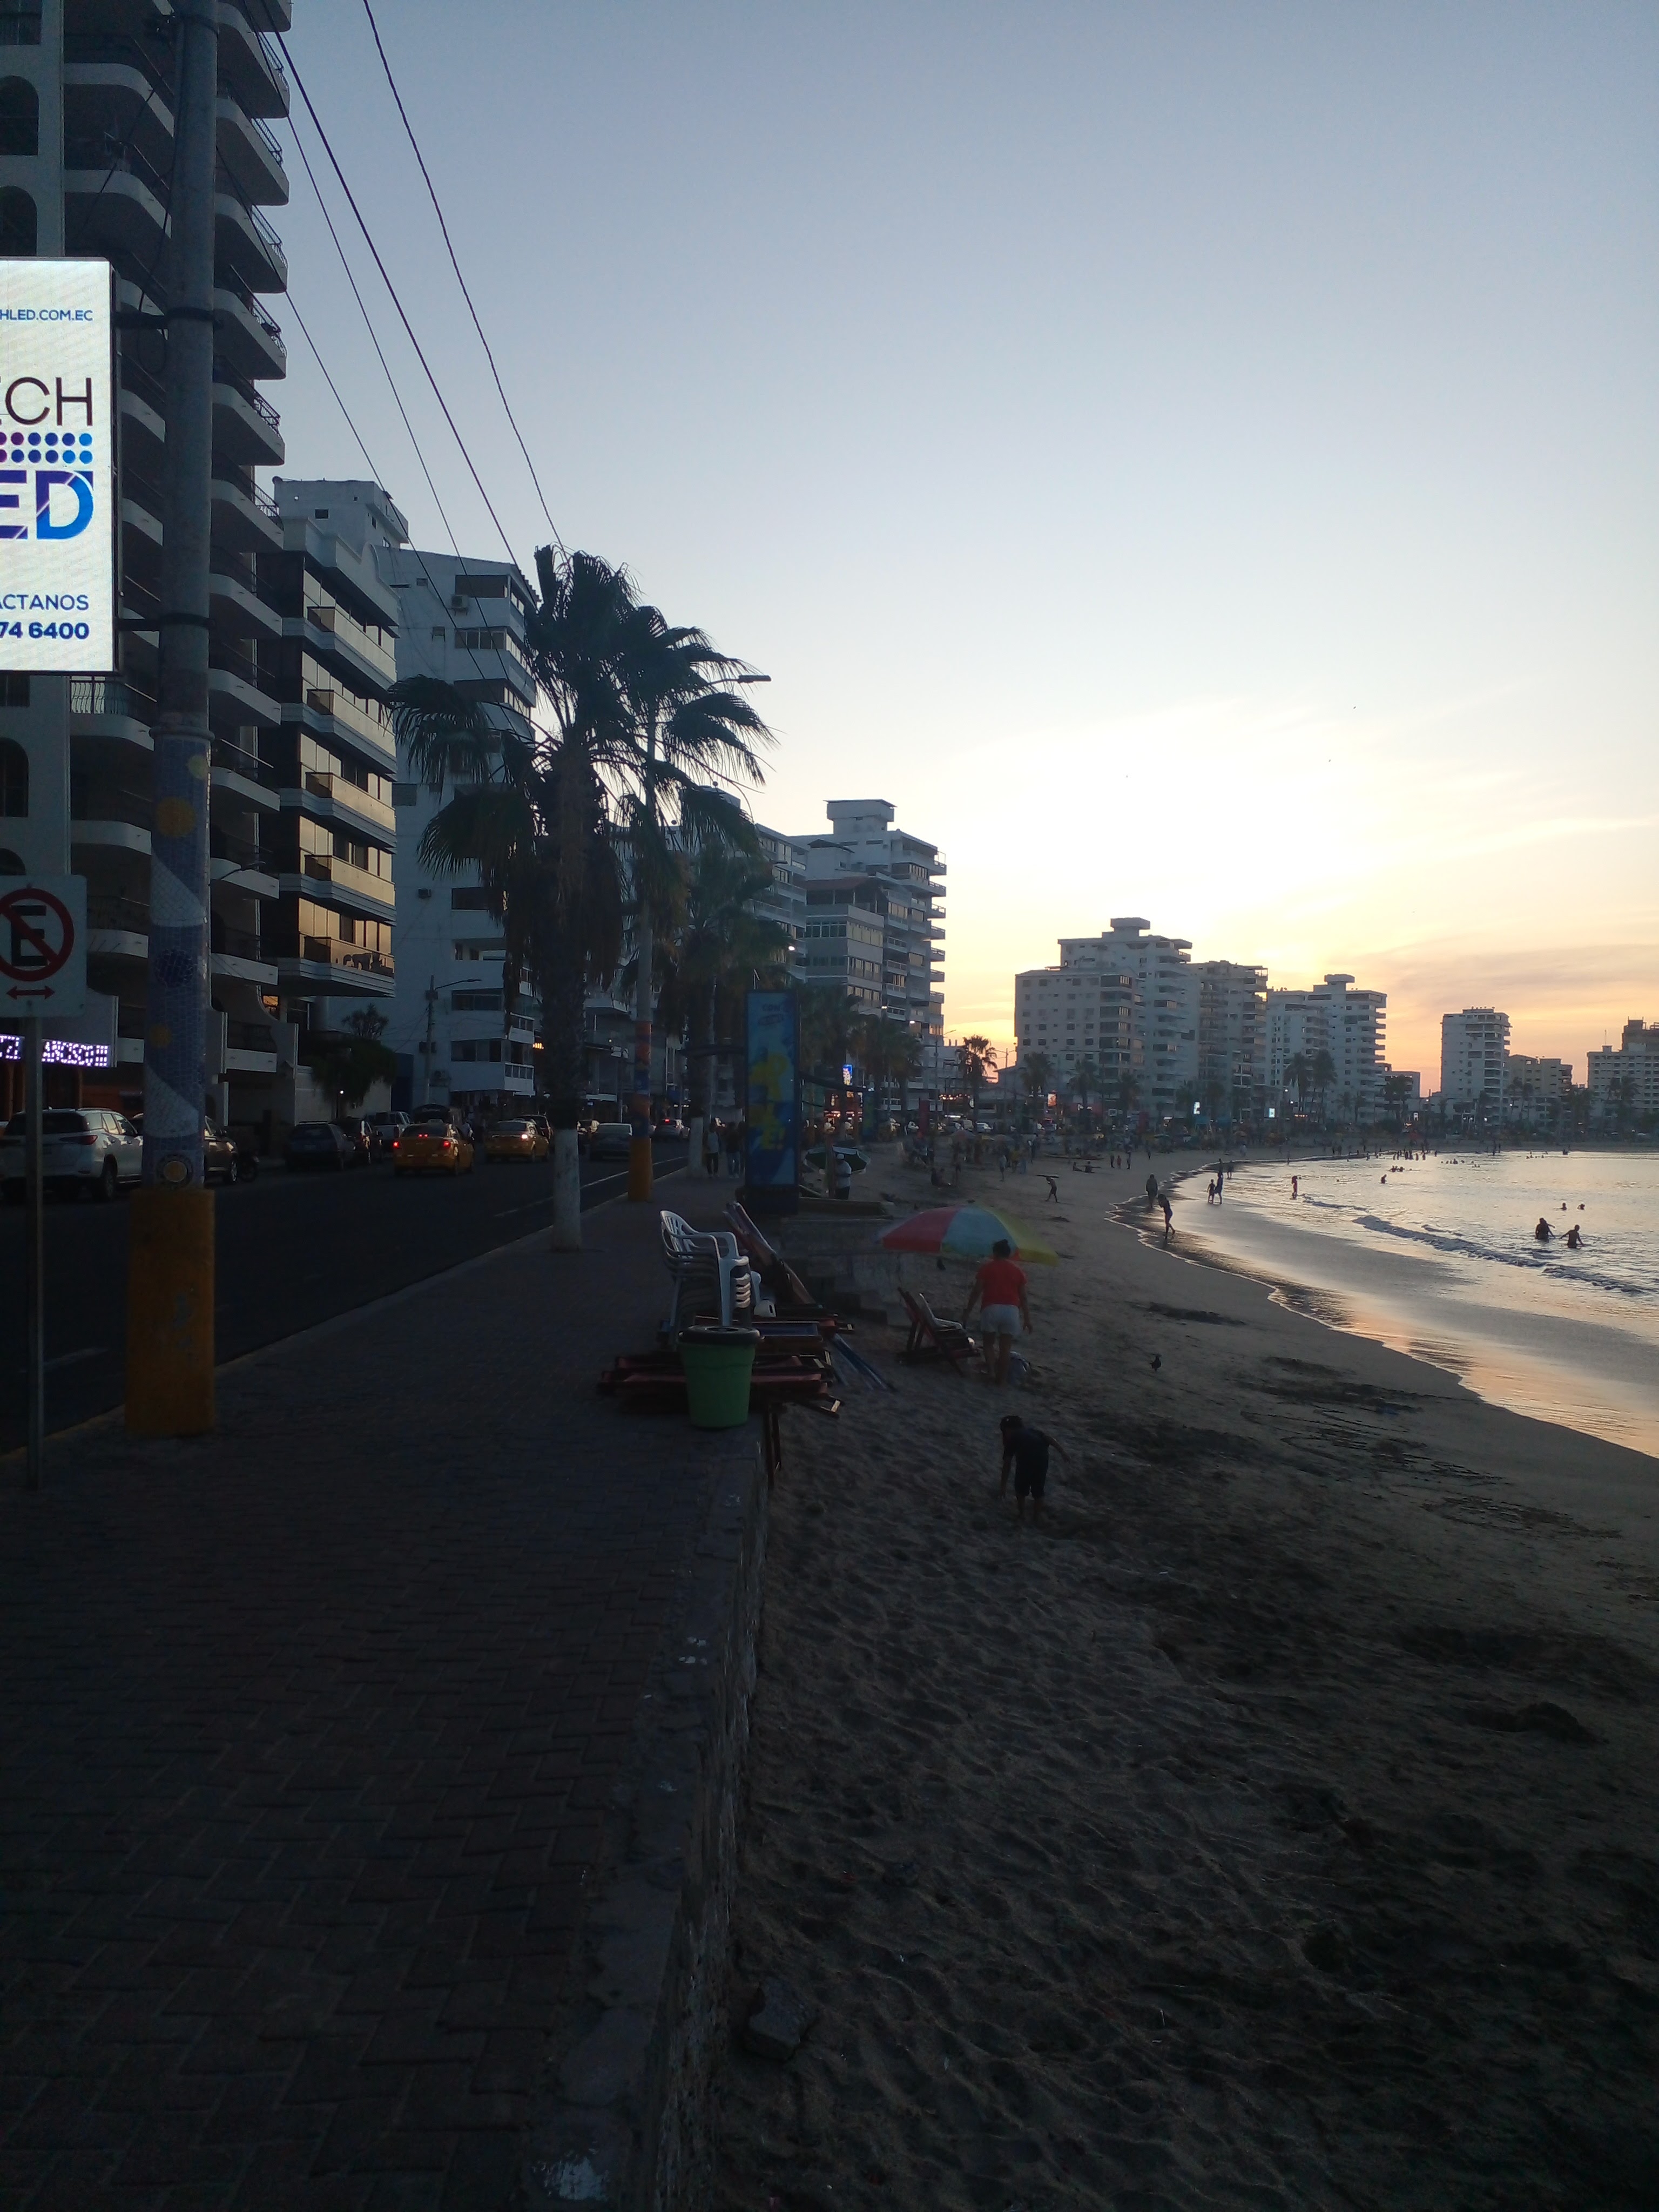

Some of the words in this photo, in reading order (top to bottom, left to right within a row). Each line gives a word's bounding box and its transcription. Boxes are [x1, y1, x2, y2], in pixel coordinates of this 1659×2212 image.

[0, 376, 93, 426] CH
[0, 622, 23, 639] 74
[29, 622, 89, 639] 6400
